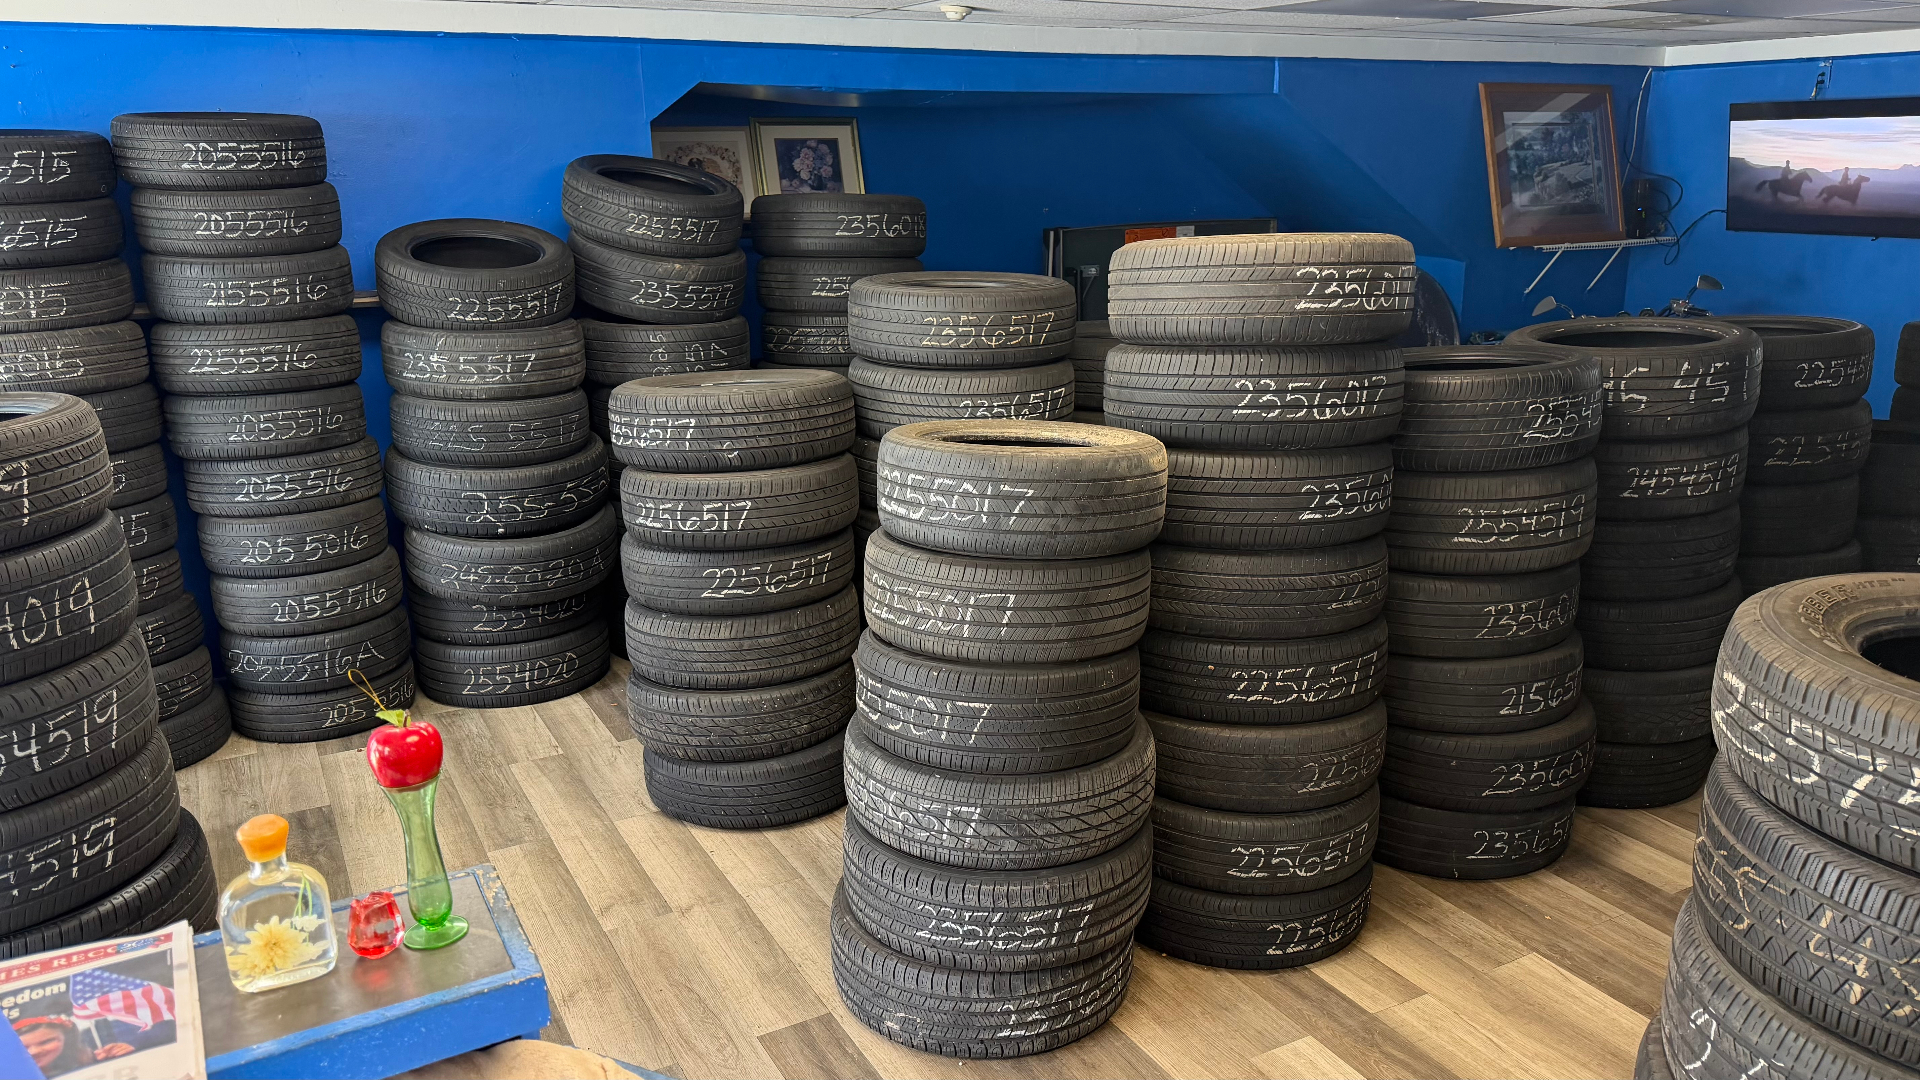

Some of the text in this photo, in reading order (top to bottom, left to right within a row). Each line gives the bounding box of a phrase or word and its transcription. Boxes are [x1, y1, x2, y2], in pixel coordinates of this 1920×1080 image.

[182, 141, 306, 171] 2055516
[194, 210, 309, 238] 2055516
[626, 212, 720, 244] 2255517
[447, 282, 563, 323] 2255517
[228, 407, 344, 441] 2055516
[234, 467, 354, 501] 2055516
[635, 500, 752, 533] 2256517
[701, 551, 832, 598] 2256517
[270, 580, 389, 623] 2055516
[461, 652, 579, 696] 2554020
[1227, 650, 1378, 705] 2256517
[1226, 822, 1369, 879] 2256517
[0, 983, 66, 1009] edom
